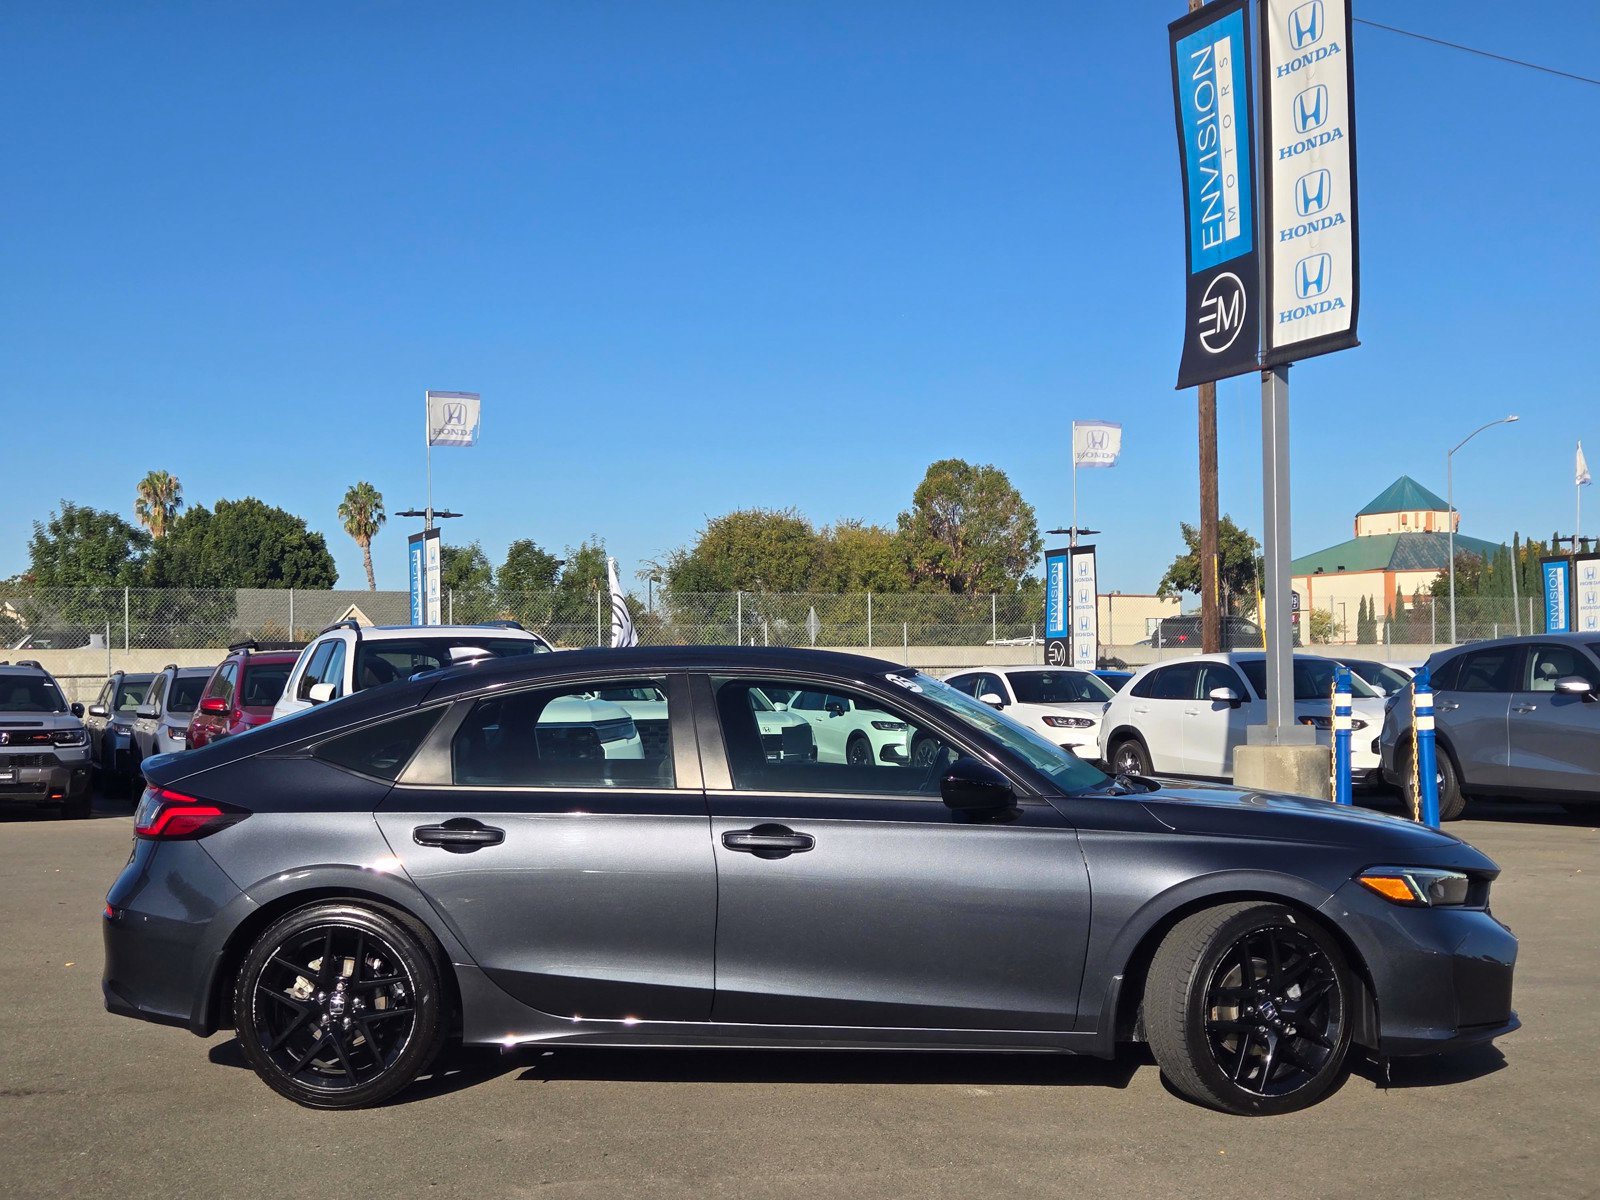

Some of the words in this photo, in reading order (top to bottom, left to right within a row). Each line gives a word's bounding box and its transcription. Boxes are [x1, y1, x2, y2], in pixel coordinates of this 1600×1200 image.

[1277, 42, 1341, 78] HONDA
[1191, 45, 1223, 250] ENVISION
[1219, 56, 1237, 222] MOTORS
[1279, 127, 1343, 160] HONDA
[1280, 212, 1346, 242] HONDA
[1279, 297, 1346, 324] HONDA
[1050, 562, 1058, 631] ENVISION
[1548, 568, 1559, 629] ENVISION
